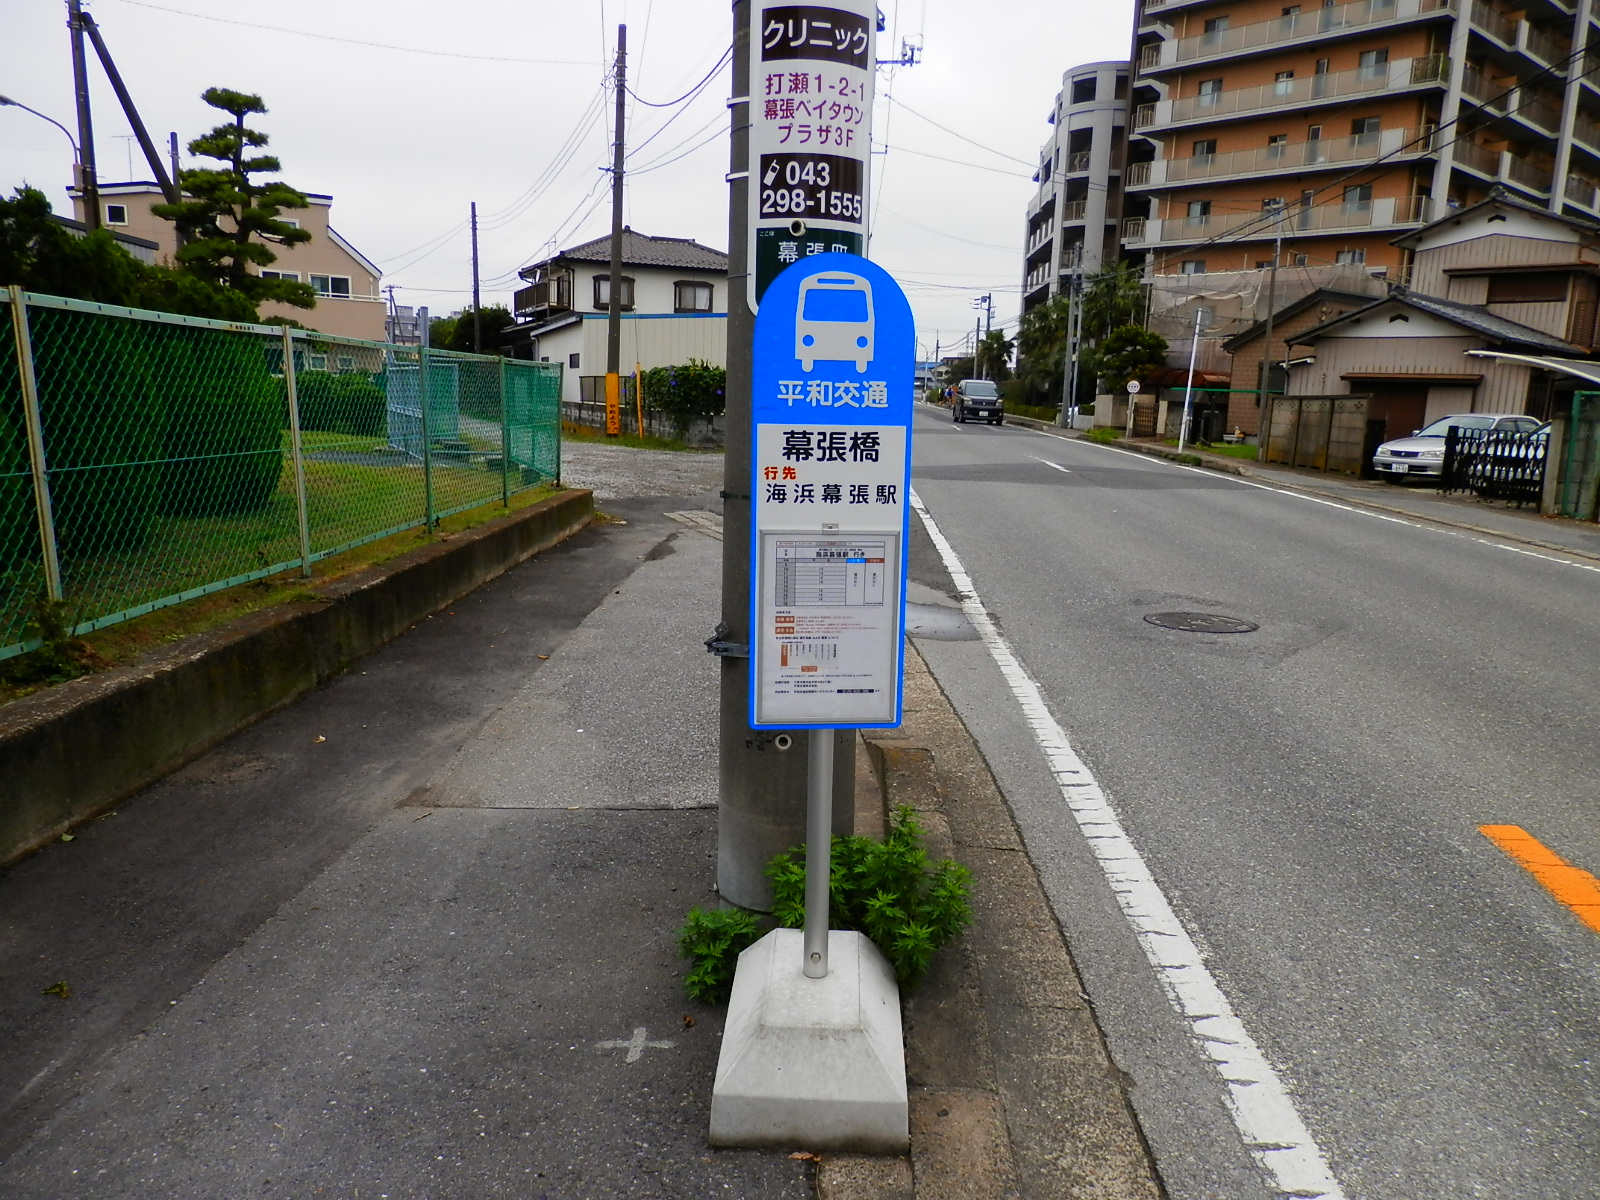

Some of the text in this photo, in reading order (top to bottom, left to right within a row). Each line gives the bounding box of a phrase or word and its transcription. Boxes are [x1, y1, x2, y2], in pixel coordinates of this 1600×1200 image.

[763, 18, 868, 55] クリニック
[765, 72, 864, 101] 打瀬1-2-1
[764, 98, 864, 125] 幕張ベイタウン
[778, 123, 854, 147] プラザ3F
[785, 161, 831, 187] 043
[762, 188, 862, 219] 298-1555
[777, 380, 889, 408] 平和交通
[782, 430, 880, 462] 幕張橋
[764, 466, 797, 480] 行先
[765, 483, 897, 504] 海浜幕張駅
